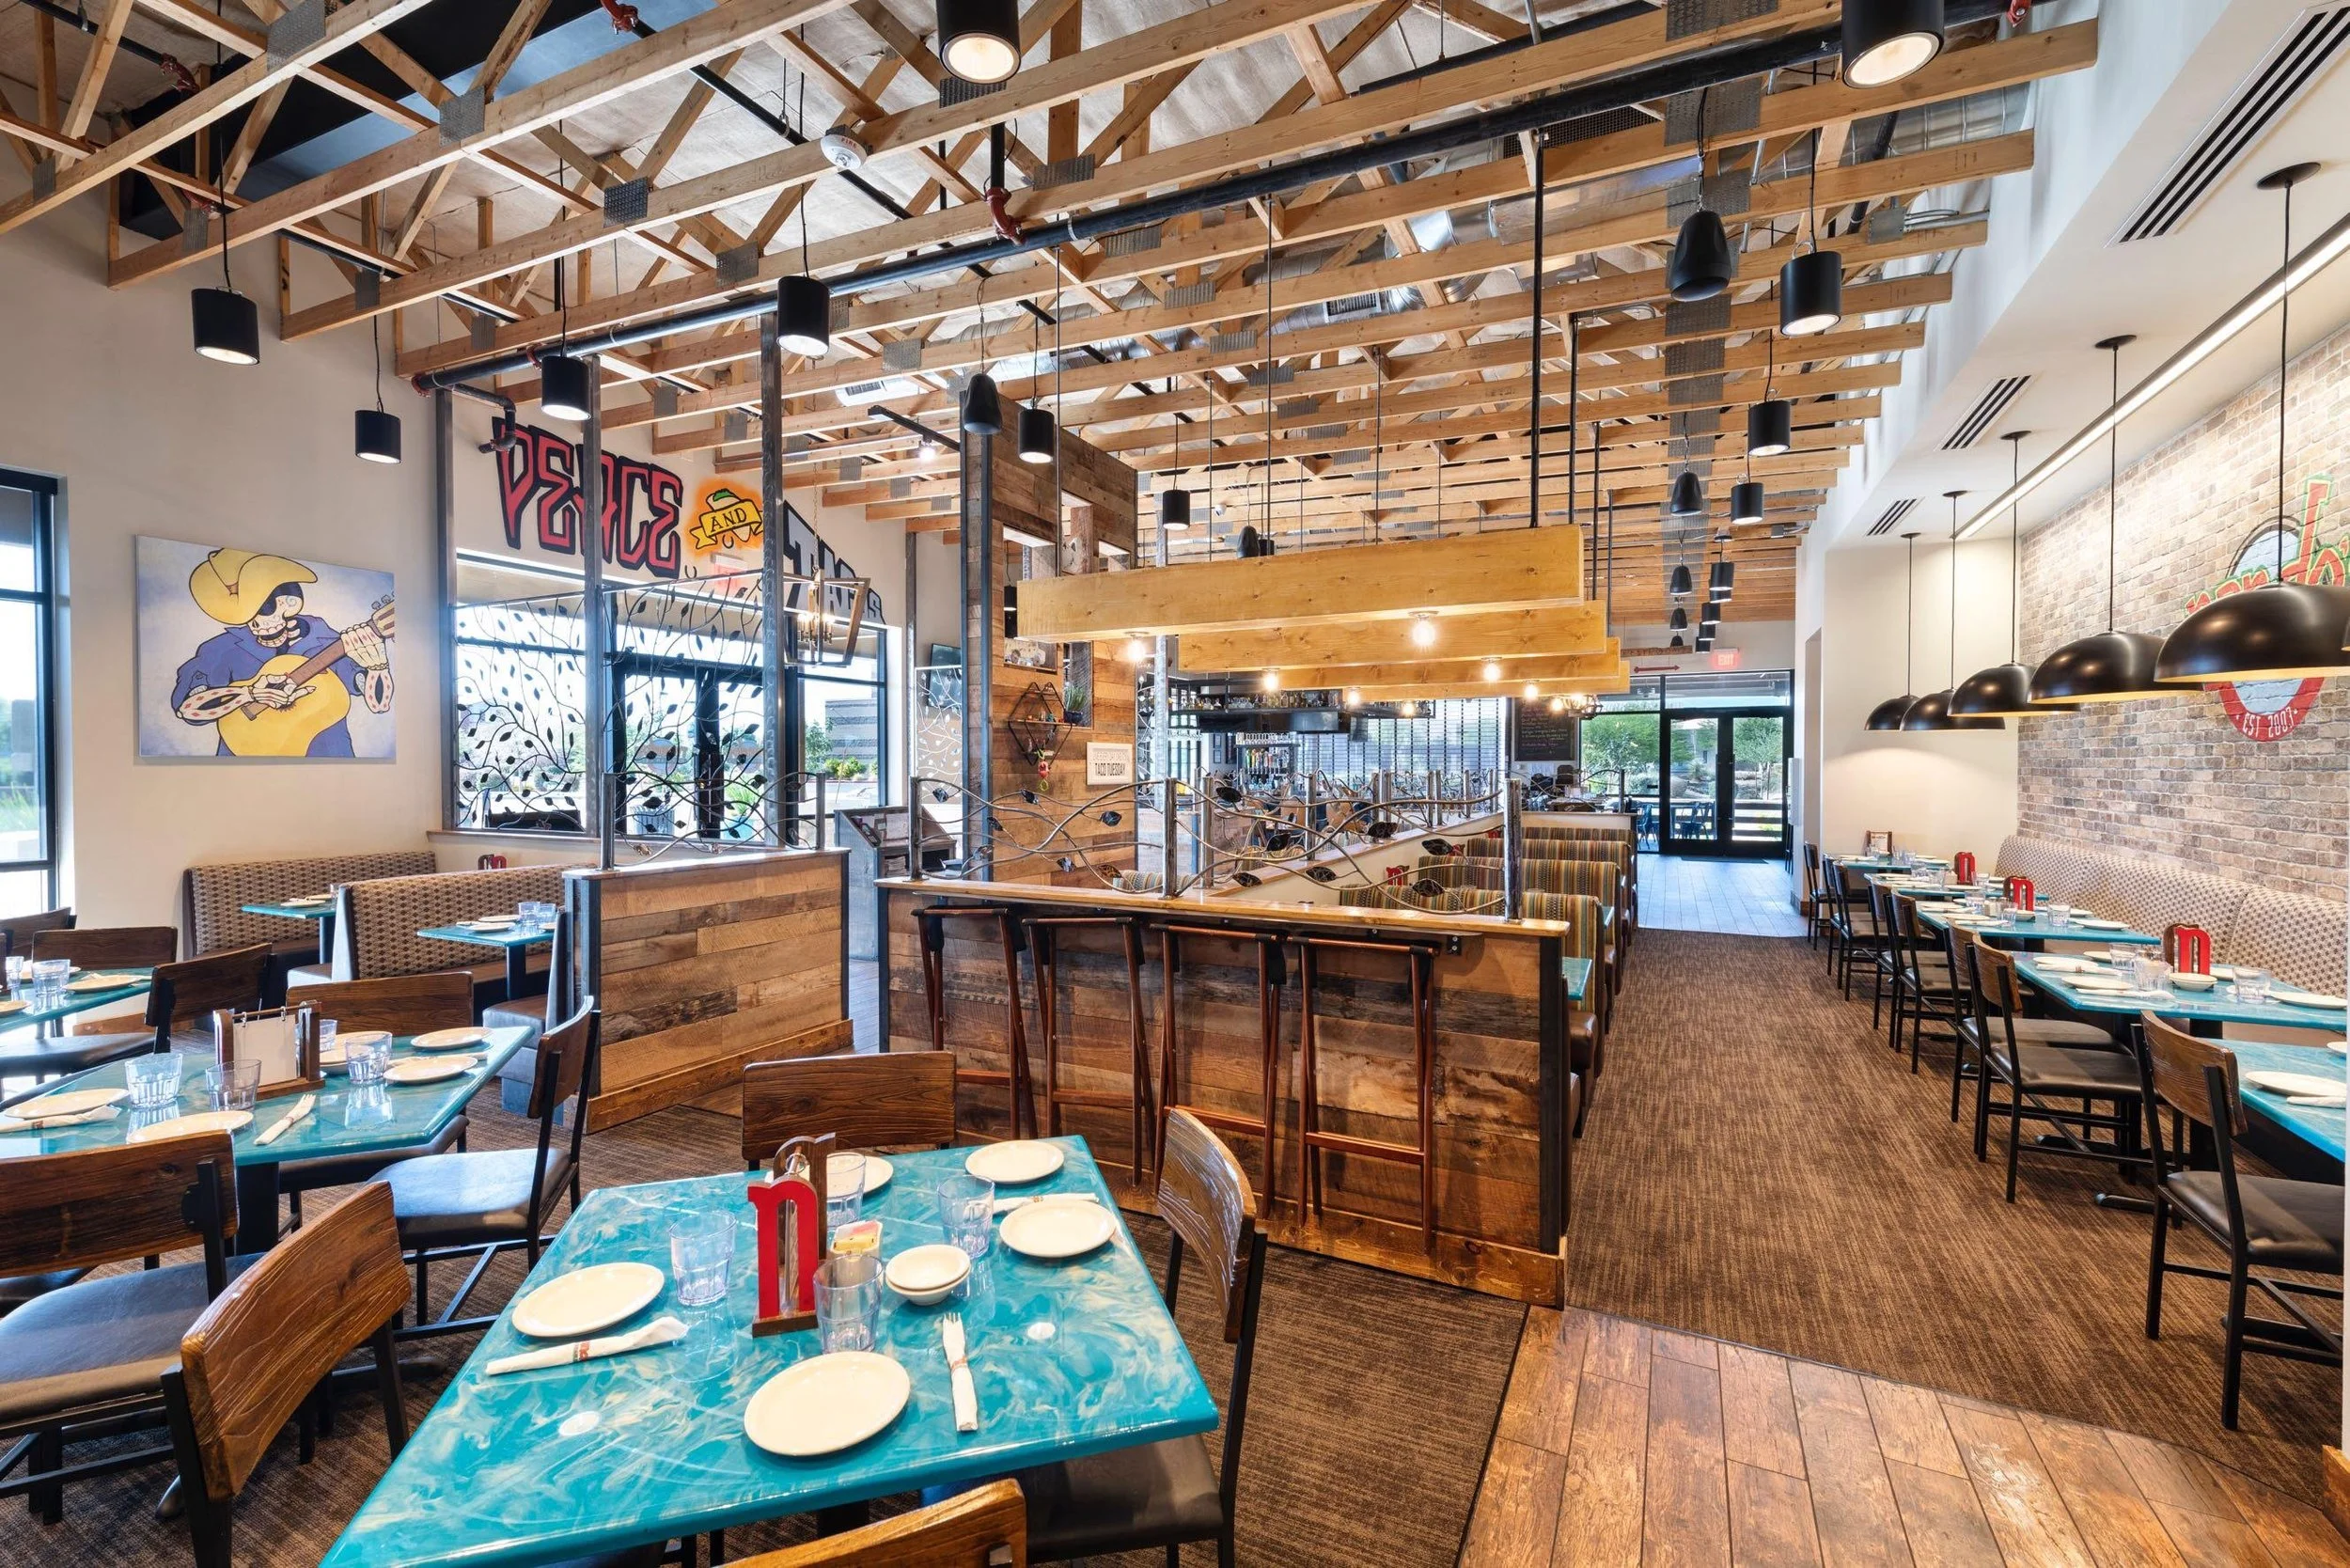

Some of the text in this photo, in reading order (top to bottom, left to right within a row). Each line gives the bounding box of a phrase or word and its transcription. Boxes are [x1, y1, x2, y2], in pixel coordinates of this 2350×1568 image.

[840, 136, 856, 149] FIRE
[492, 416, 886, 624] PEACE AND TACS
[1717, 653, 1734, 666] EXIT
[2242, 712, 2261, 738] EST
[1095, 762, 1126, 776] TACO TUESDAY
